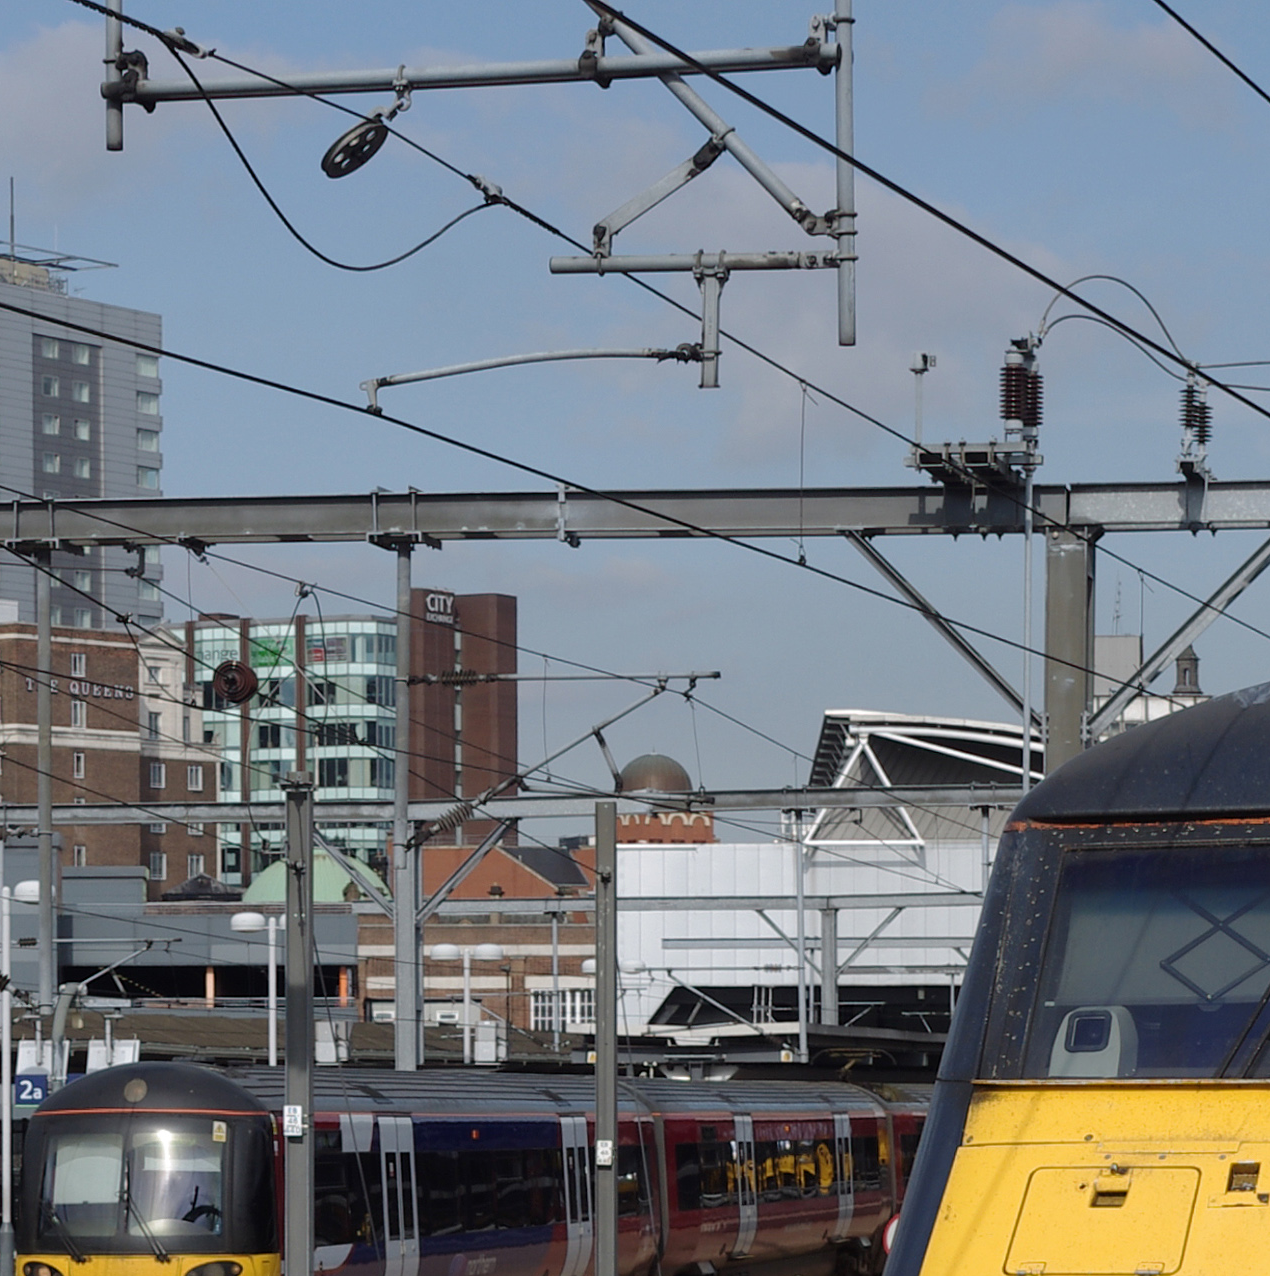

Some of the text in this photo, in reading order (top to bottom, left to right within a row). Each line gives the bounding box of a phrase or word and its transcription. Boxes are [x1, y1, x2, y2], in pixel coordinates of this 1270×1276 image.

[426, 593, 454, 614] CITY
[26, 678, 134, 700] TE QUEENS
[20, 1080, 42, 1100] 2a
